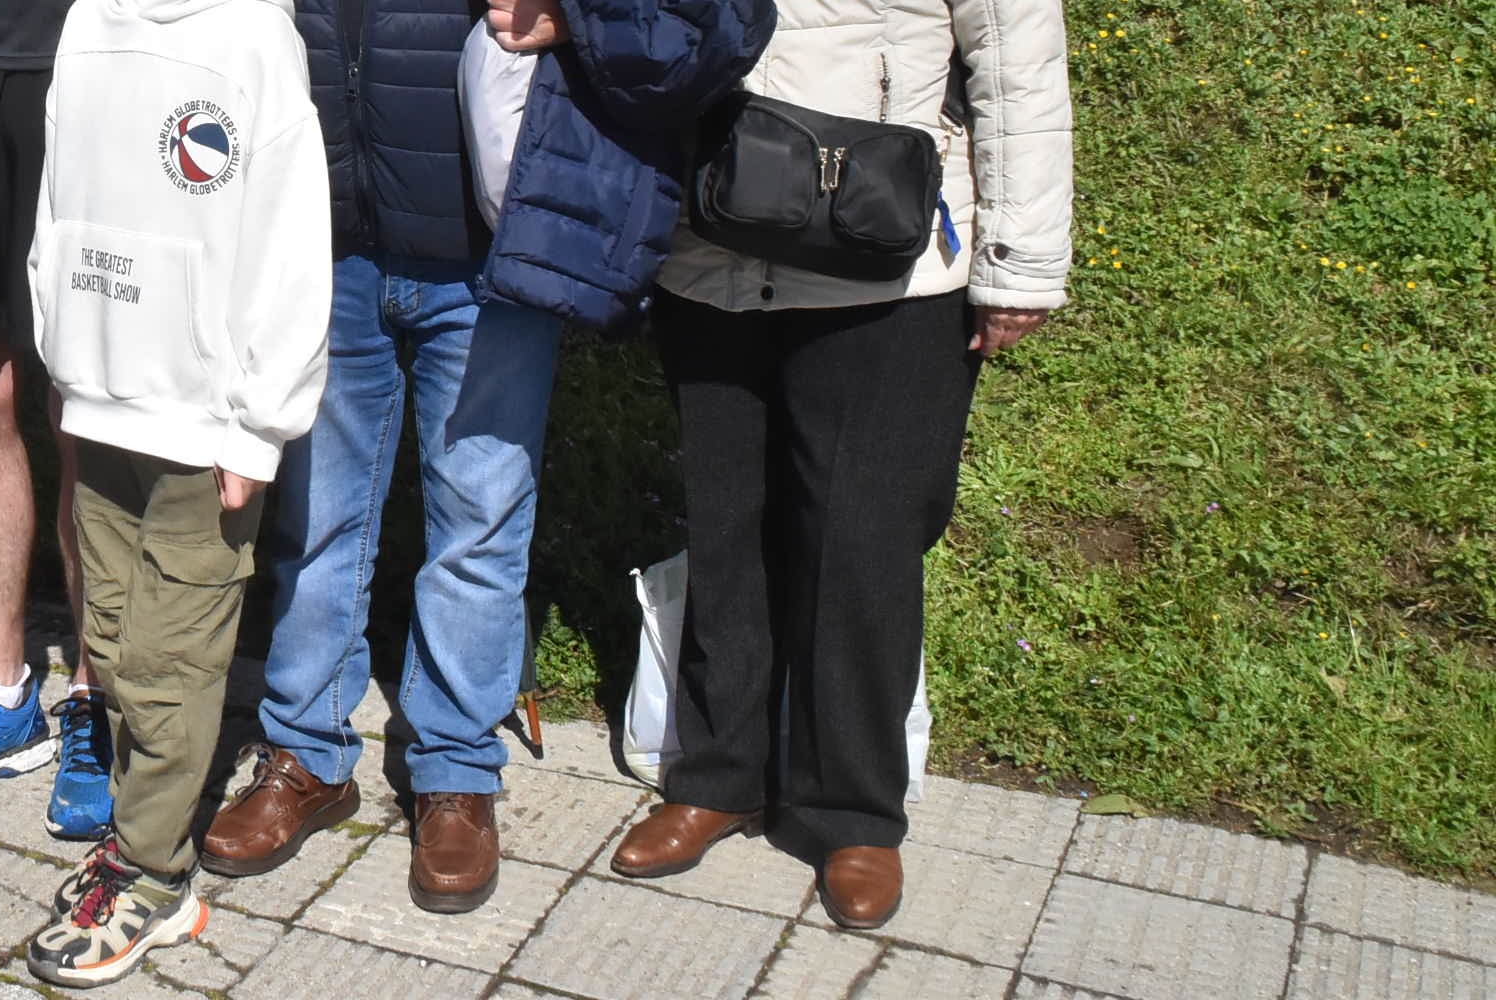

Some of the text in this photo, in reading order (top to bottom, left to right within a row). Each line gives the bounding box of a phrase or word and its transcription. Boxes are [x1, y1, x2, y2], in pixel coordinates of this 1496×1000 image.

[158, 99, 238, 153] HARLEM GLOBETROTTERS
[161, 143, 241, 196] HARLEM GLOBETROTTERS
[81, 247, 134, 277] THE GREATEST
[71, 271, 141, 305] BASKETBALL SHOW
